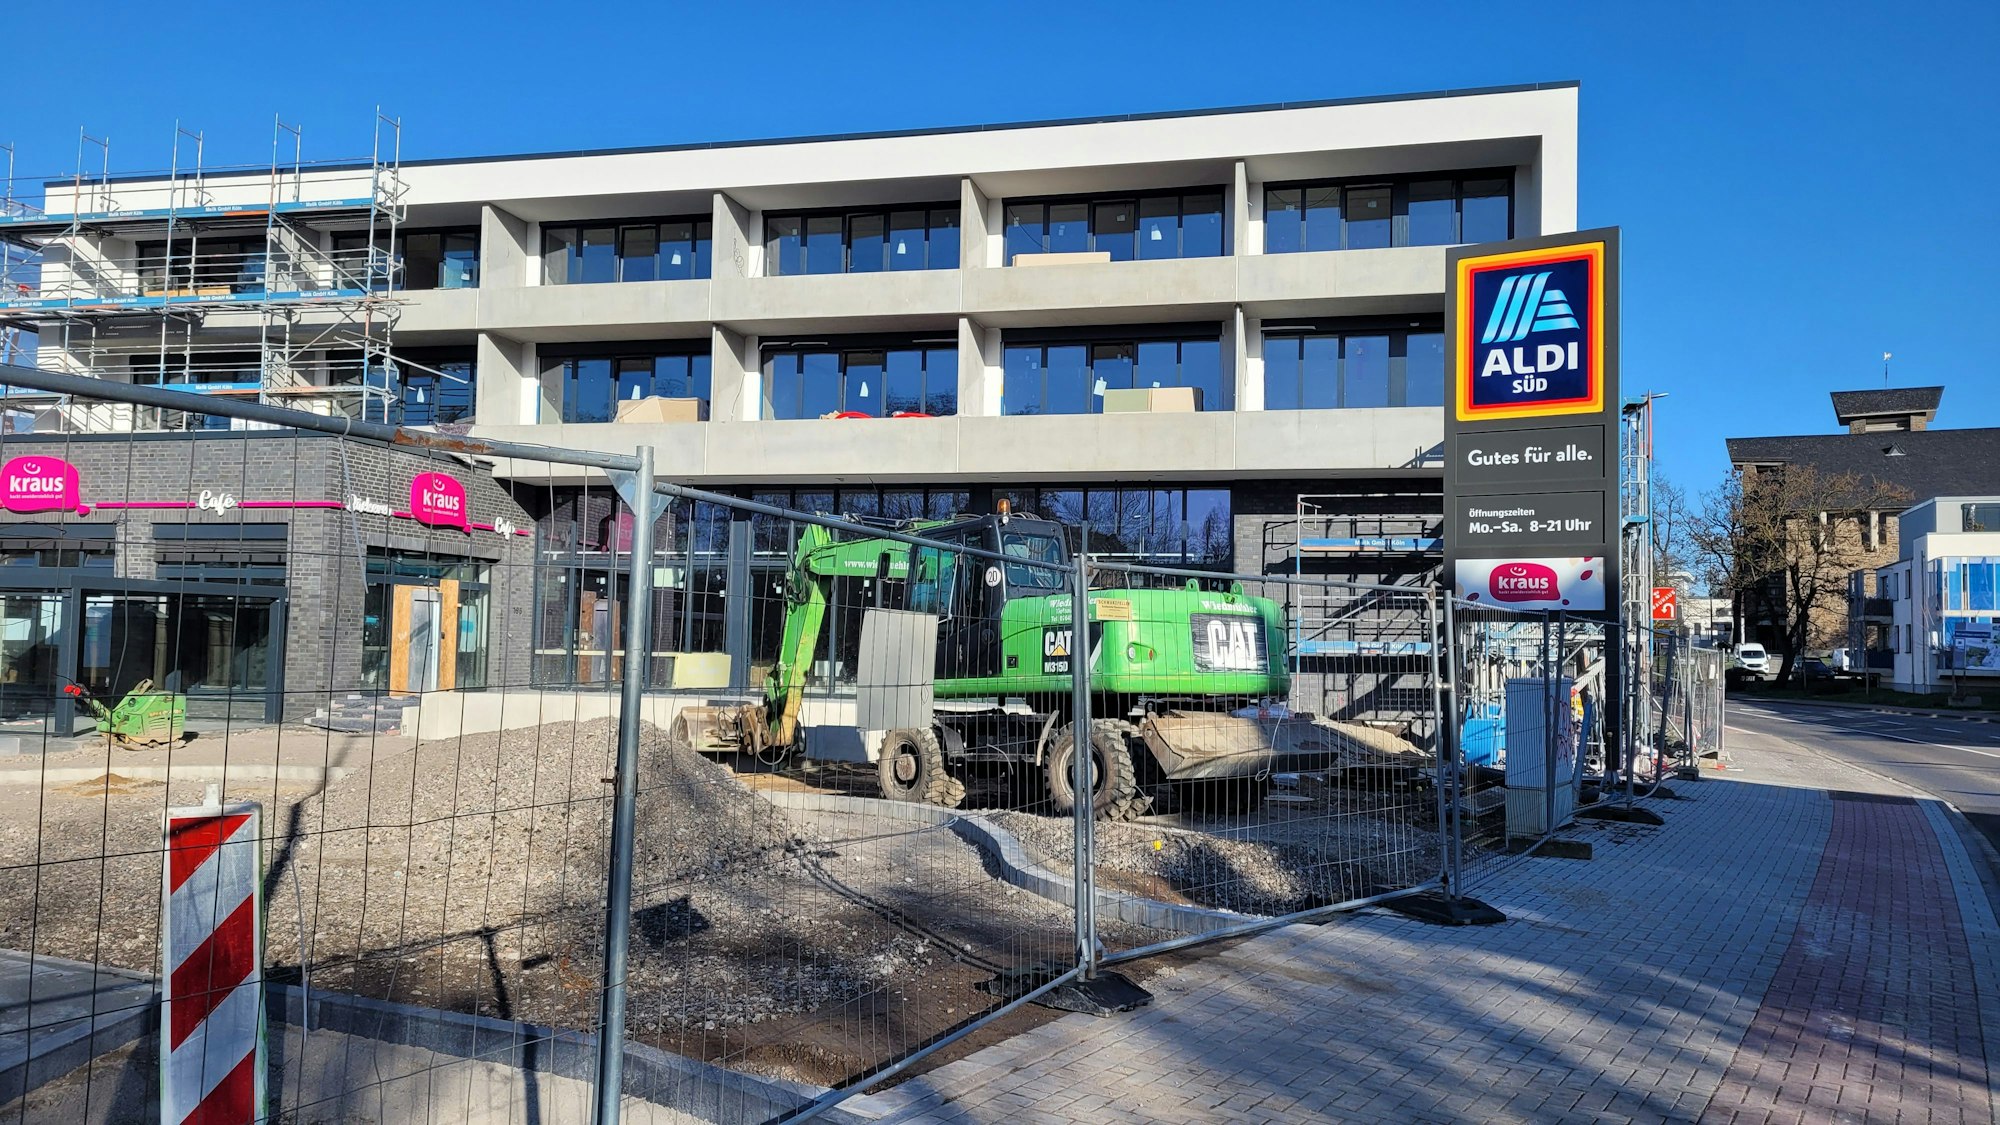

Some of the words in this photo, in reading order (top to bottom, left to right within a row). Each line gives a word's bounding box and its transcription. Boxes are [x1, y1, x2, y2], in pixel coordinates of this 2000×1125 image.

[1481, 342, 1579, 377] ALDI
[1512, 374, 1548, 394] SÜD
[1467, 449, 1520, 466] Gutes
[1524, 446, 1551, 463] für
[1556, 444, 1593, 462] alle.
[9, 475, 64, 492] kraus
[199, 489, 236, 516] Café
[423, 489, 460, 511] kraus
[1468, 508, 1535, 518] Öffnungszeiten
[1564, 518, 1592, 531] Uhr
[988, 570, 998, 583] 20
[1498, 576, 1549, 590] kraus
[1044, 631, 1073, 657] CAT
[1207, 620, 1258, 669] CAT
[1044, 661, 1069, 673] M315D
